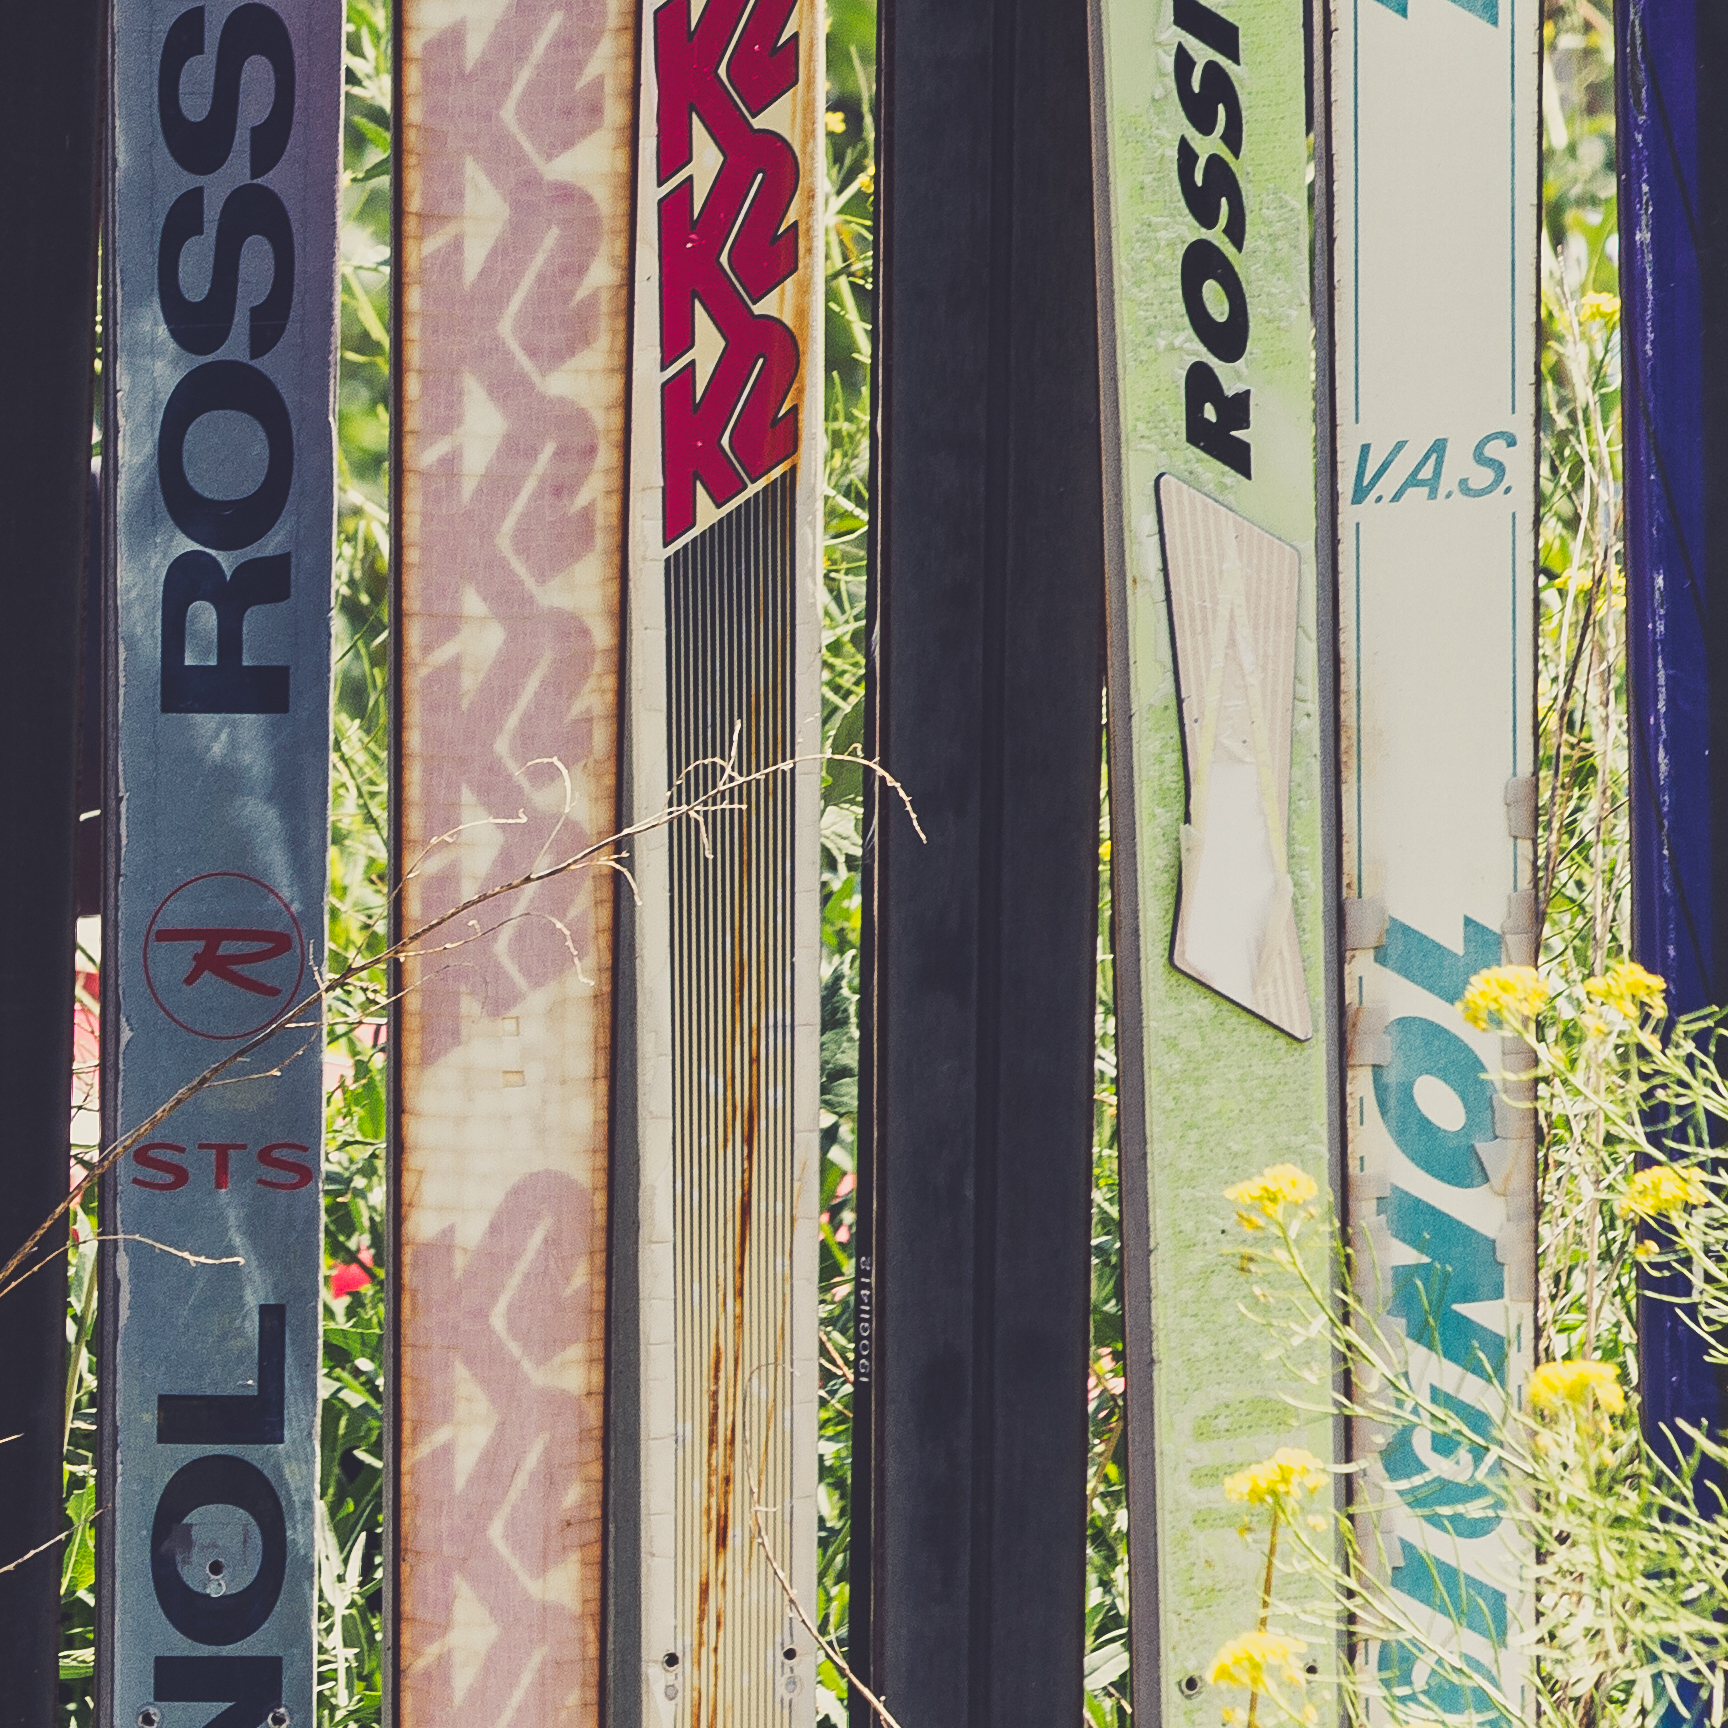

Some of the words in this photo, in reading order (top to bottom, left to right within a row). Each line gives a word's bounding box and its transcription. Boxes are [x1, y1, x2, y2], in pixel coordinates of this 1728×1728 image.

[419, 178, 604, 470] K2
[419, 394, 600, 677] K2
[1351, 428, 1518, 509] V.A.S.
[419, 604, 596, 878] K2
[129, 1141, 316, 1194] STS
[410, 1168, 592, 1468] K2
